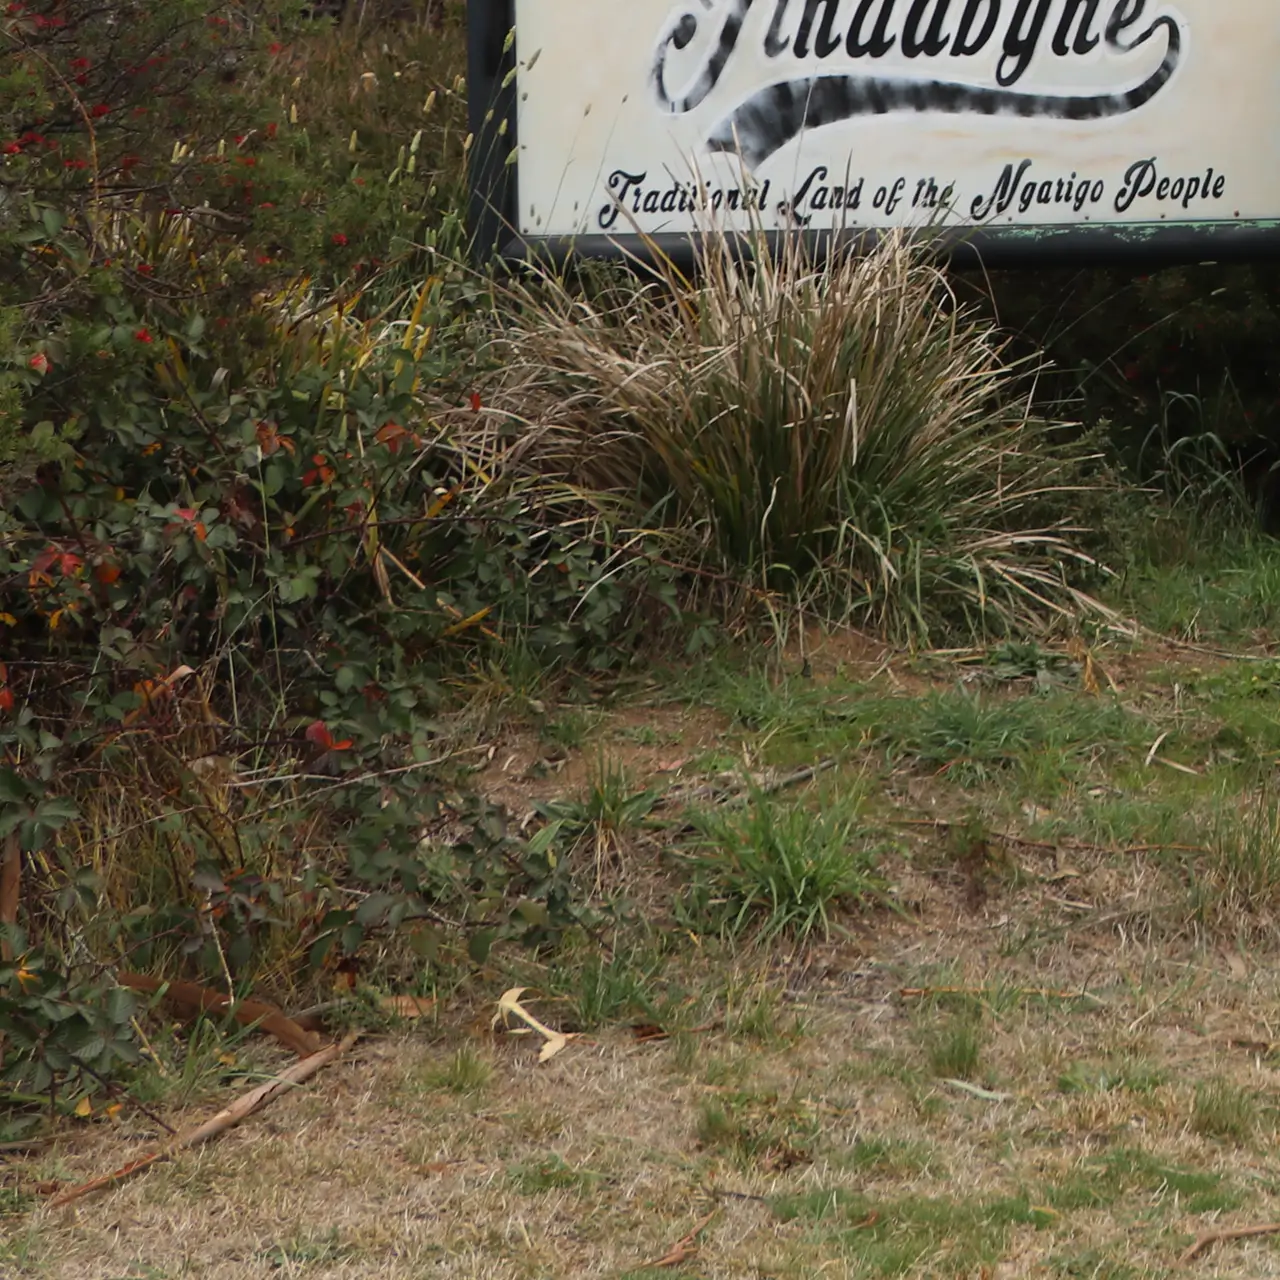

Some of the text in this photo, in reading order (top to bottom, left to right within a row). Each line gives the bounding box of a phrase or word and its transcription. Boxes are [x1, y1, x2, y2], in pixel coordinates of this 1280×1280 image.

[776, 165, 865, 226] Land
[871, 176, 906, 217] of
[911, 176, 953, 208] the
[969, 158, 1104, 221] Ngarigo
[1114, 156, 1226, 213] People
